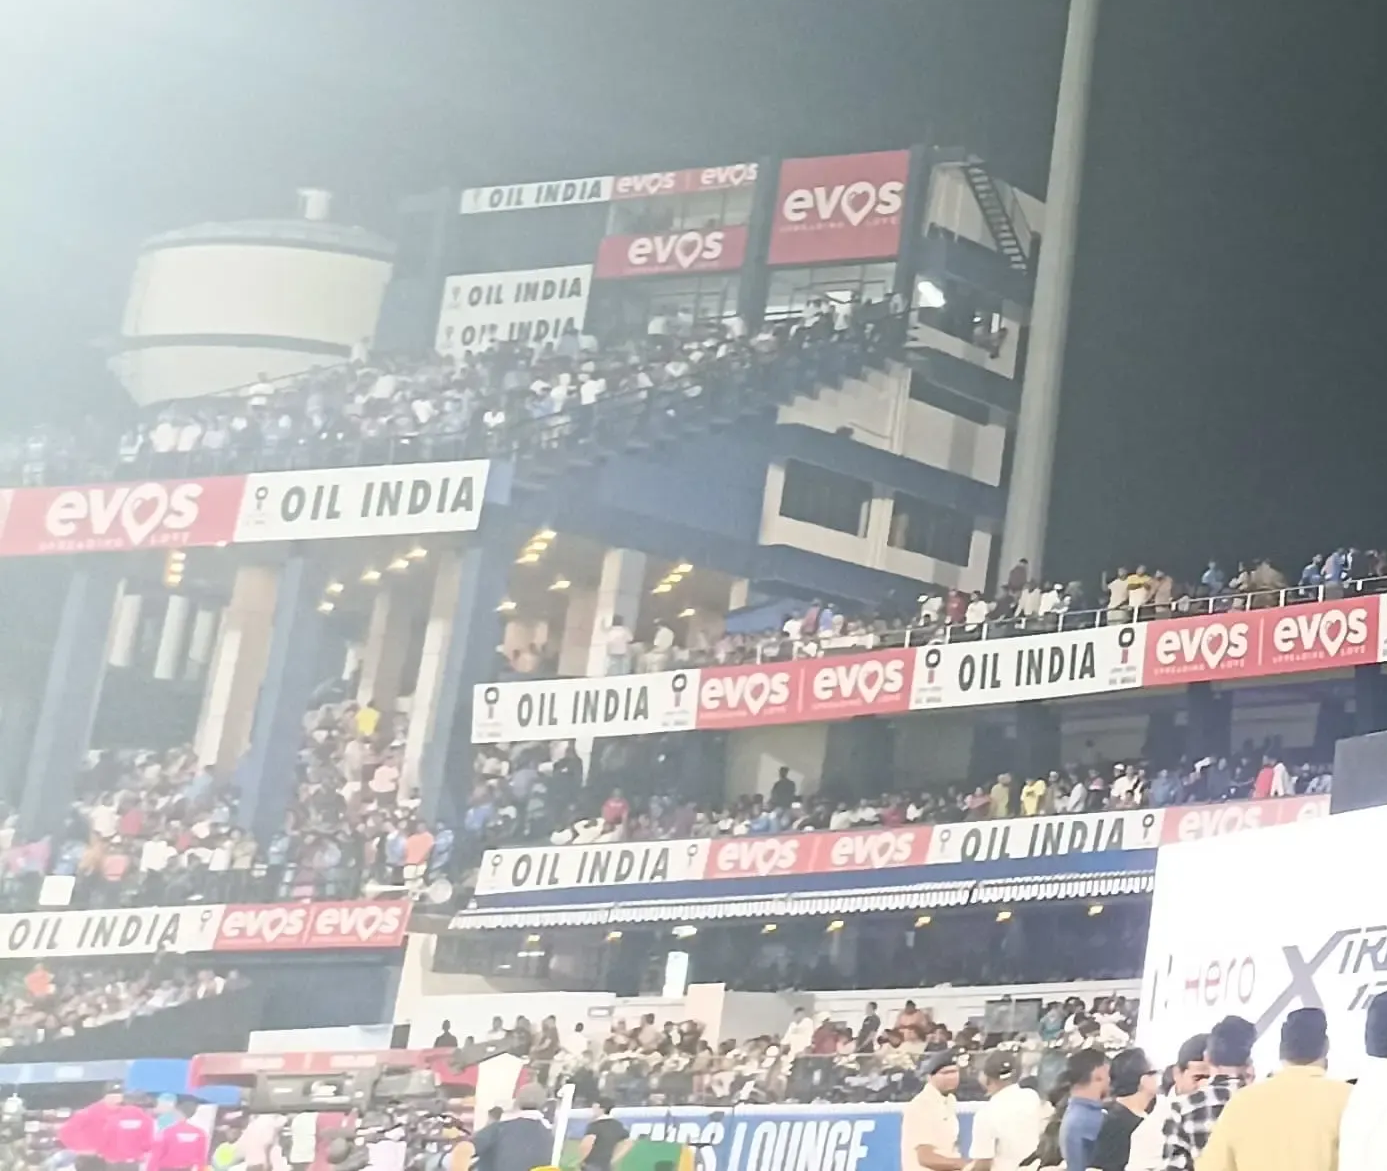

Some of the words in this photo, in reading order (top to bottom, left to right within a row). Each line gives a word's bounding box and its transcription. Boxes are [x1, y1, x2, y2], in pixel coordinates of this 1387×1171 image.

[616, 172, 677, 195] evos
[701, 163, 759, 185] evos
[488, 187, 523, 209] OIL
[535, 180, 602, 204] INDIA
[783, 181, 904, 227] evos
[628, 231, 725, 269] evos
[467, 283, 504, 307] OIL
[513, 277, 582, 303] INDIA
[45, 481, 204, 546] evos
[280, 485, 342, 523] OIL
[360, 476, 475, 518] INDIA
[1156, 622, 1249, 670] evos
[1273, 608, 1368, 658] evos
[813, 659, 904, 704] evos
[959, 653, 1001, 691] OIL
[1015, 642, 1096, 686] INDIA
[517, 692, 558, 728] OIL
[571, 686, 649, 725] INDIA
[701, 672, 791, 715] evos
[717, 838, 799, 876] evos
[830, 831, 915, 868] evos
[1028, 817, 1124, 857] INDIA
[512, 852, 560, 887] OIL
[575, 847, 670, 884] INDIA
[8, 918, 60, 951] OIL
[77, 913, 181, 949] INDIA
[221, 908, 306, 943] evos
[316, 906, 402, 942] evos
[1184, 955, 1256, 1006] Hero
